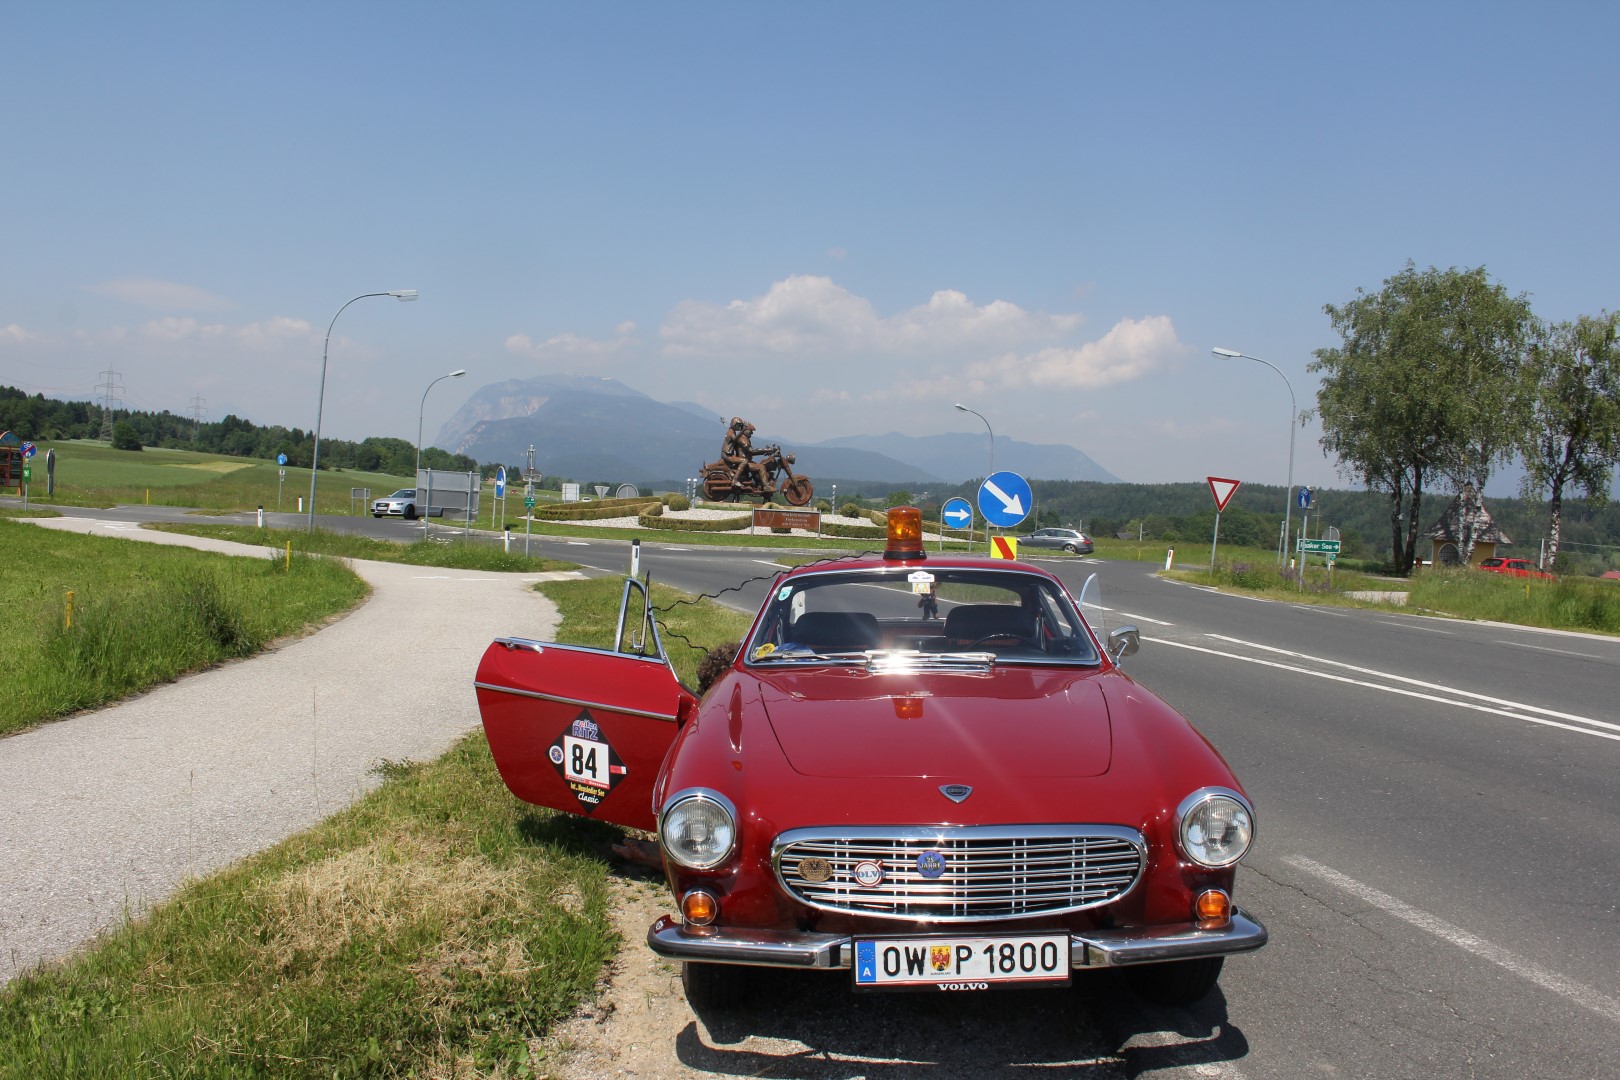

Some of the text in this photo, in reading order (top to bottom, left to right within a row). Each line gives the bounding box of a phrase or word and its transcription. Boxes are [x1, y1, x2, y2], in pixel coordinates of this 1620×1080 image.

[572, 726, 598, 740] RITZ
[572, 743, 597, 779] 84
[883, 941, 1058, 977] OW P 1800
[862, 967, 872, 977] A
[937, 982, 989, 991] VOLVO
